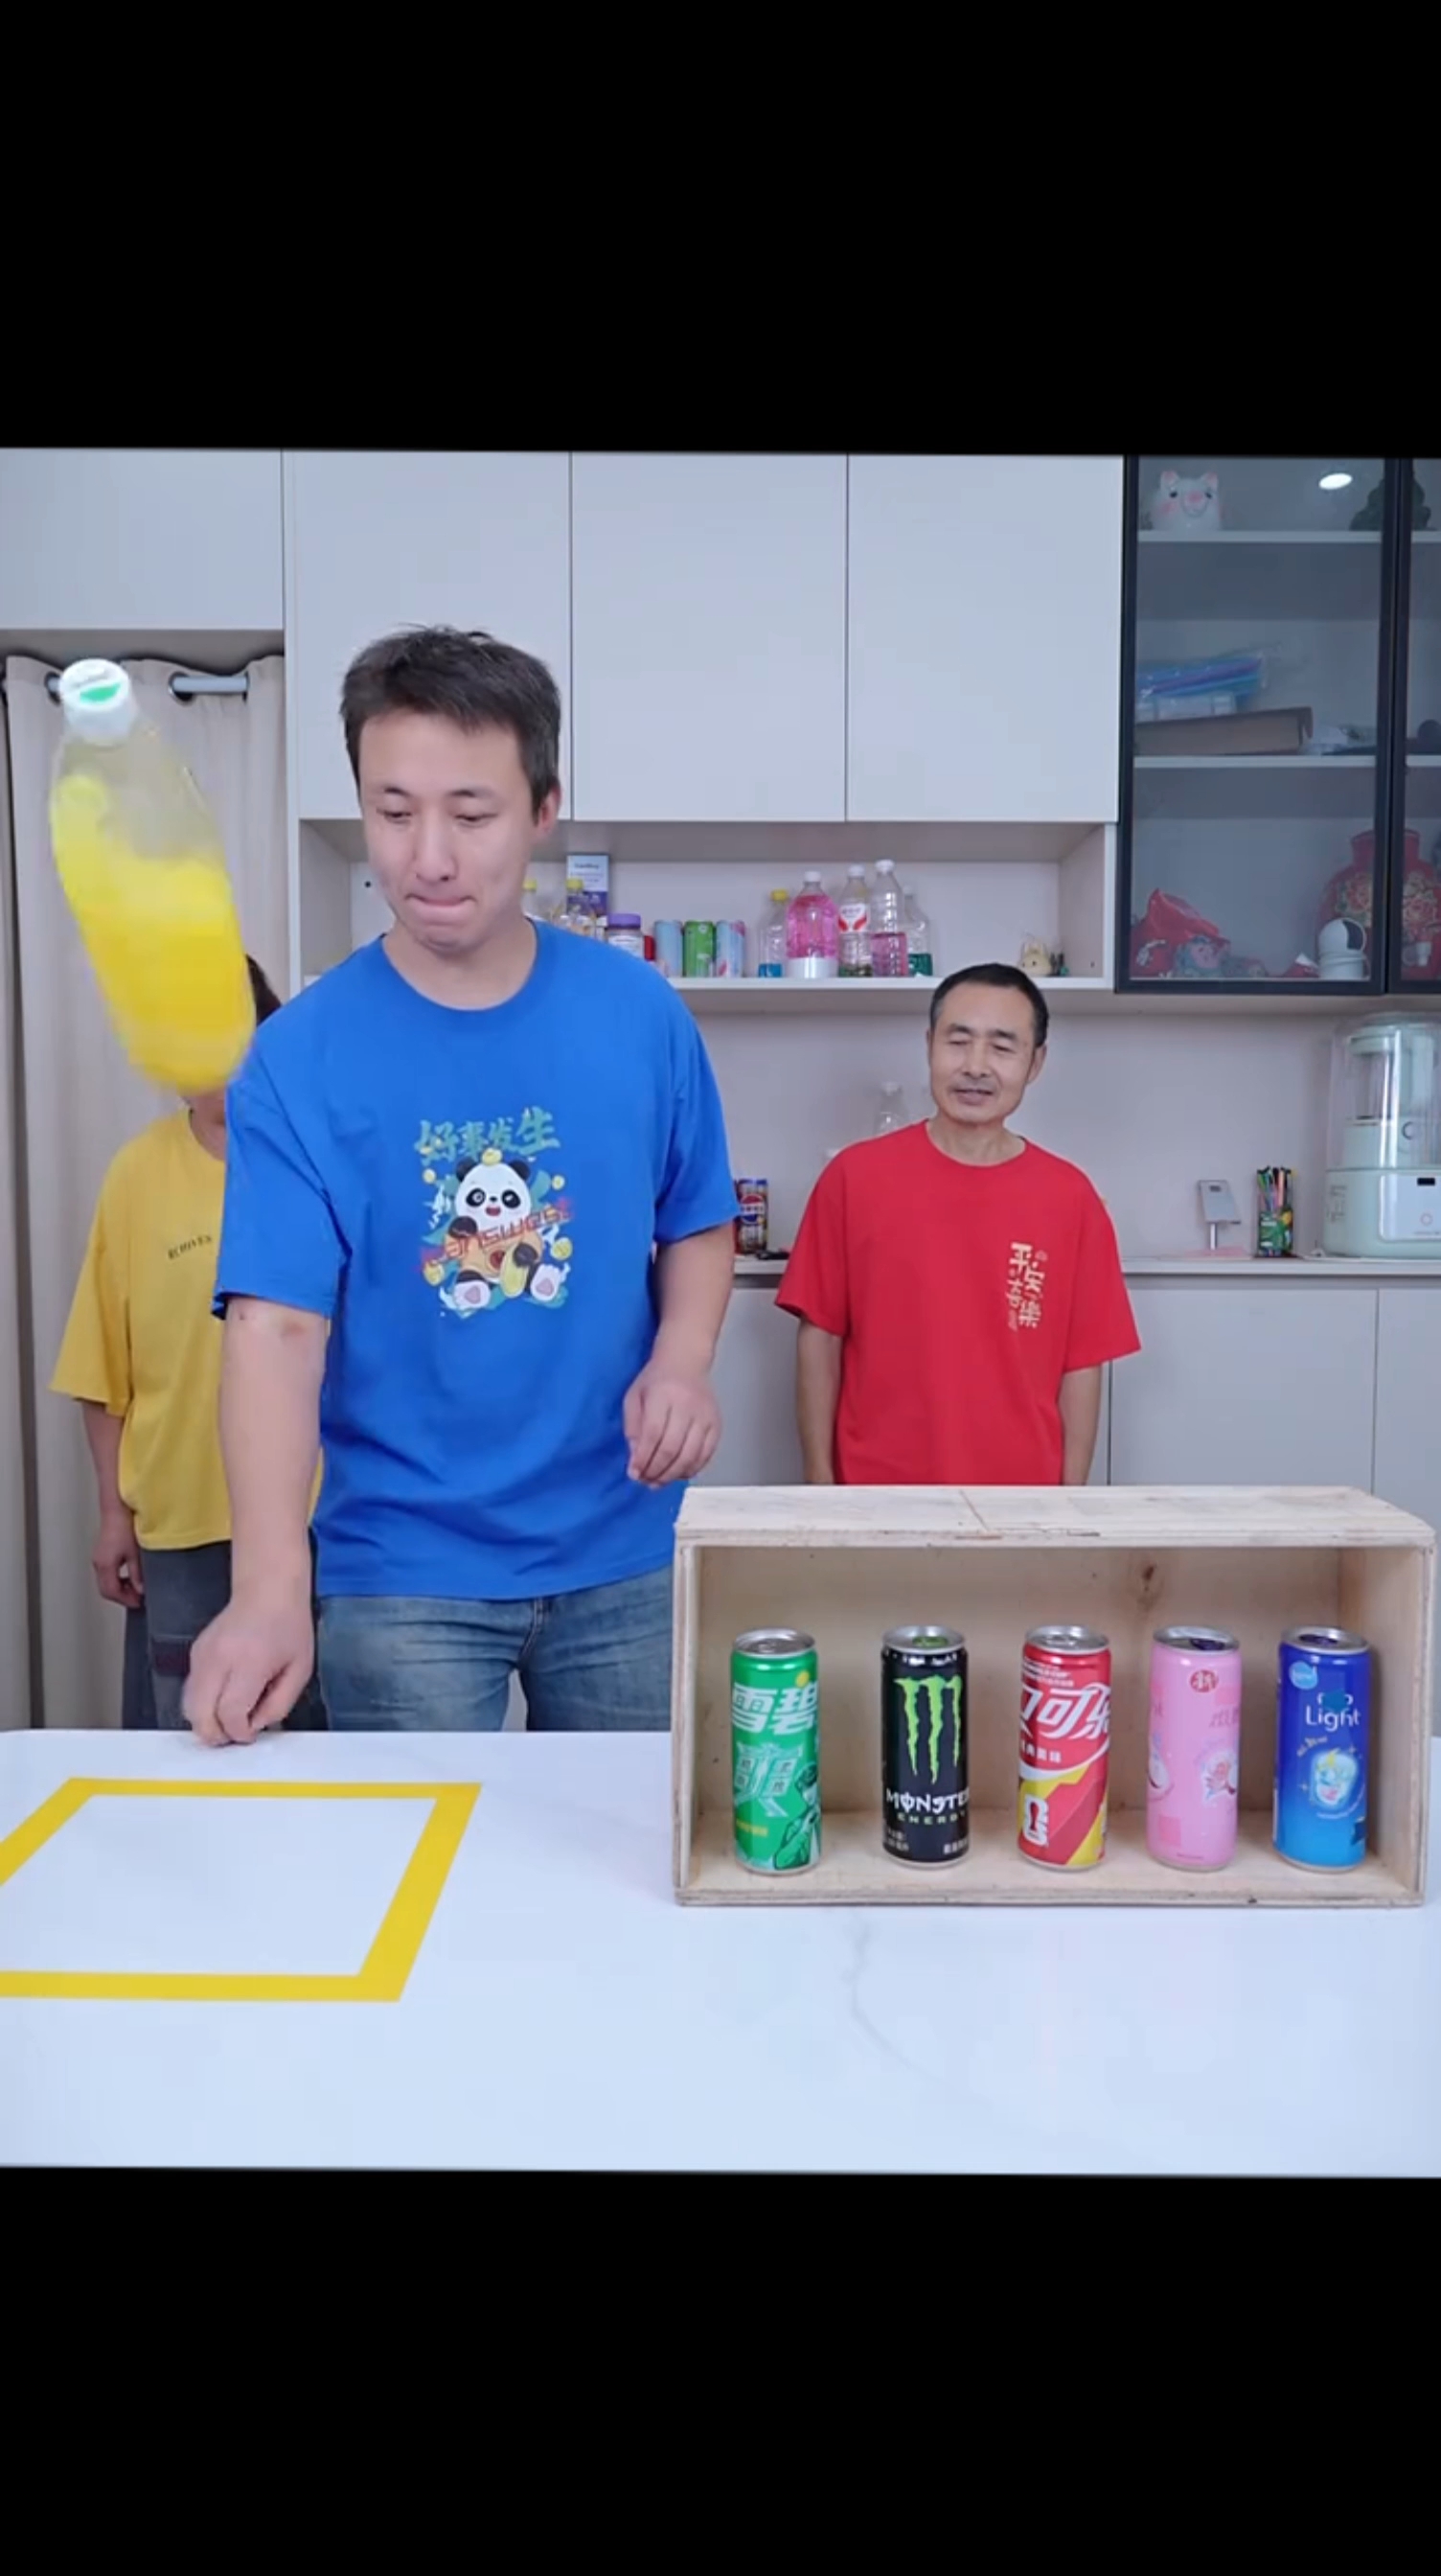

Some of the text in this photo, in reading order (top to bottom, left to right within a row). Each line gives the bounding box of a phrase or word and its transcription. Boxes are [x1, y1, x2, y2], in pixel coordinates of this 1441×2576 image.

[414, 1106, 561, 1165] 好事发生
[731, 1681, 819, 1736] 雪碧
[1305, 1705, 1361, 1733] Light
